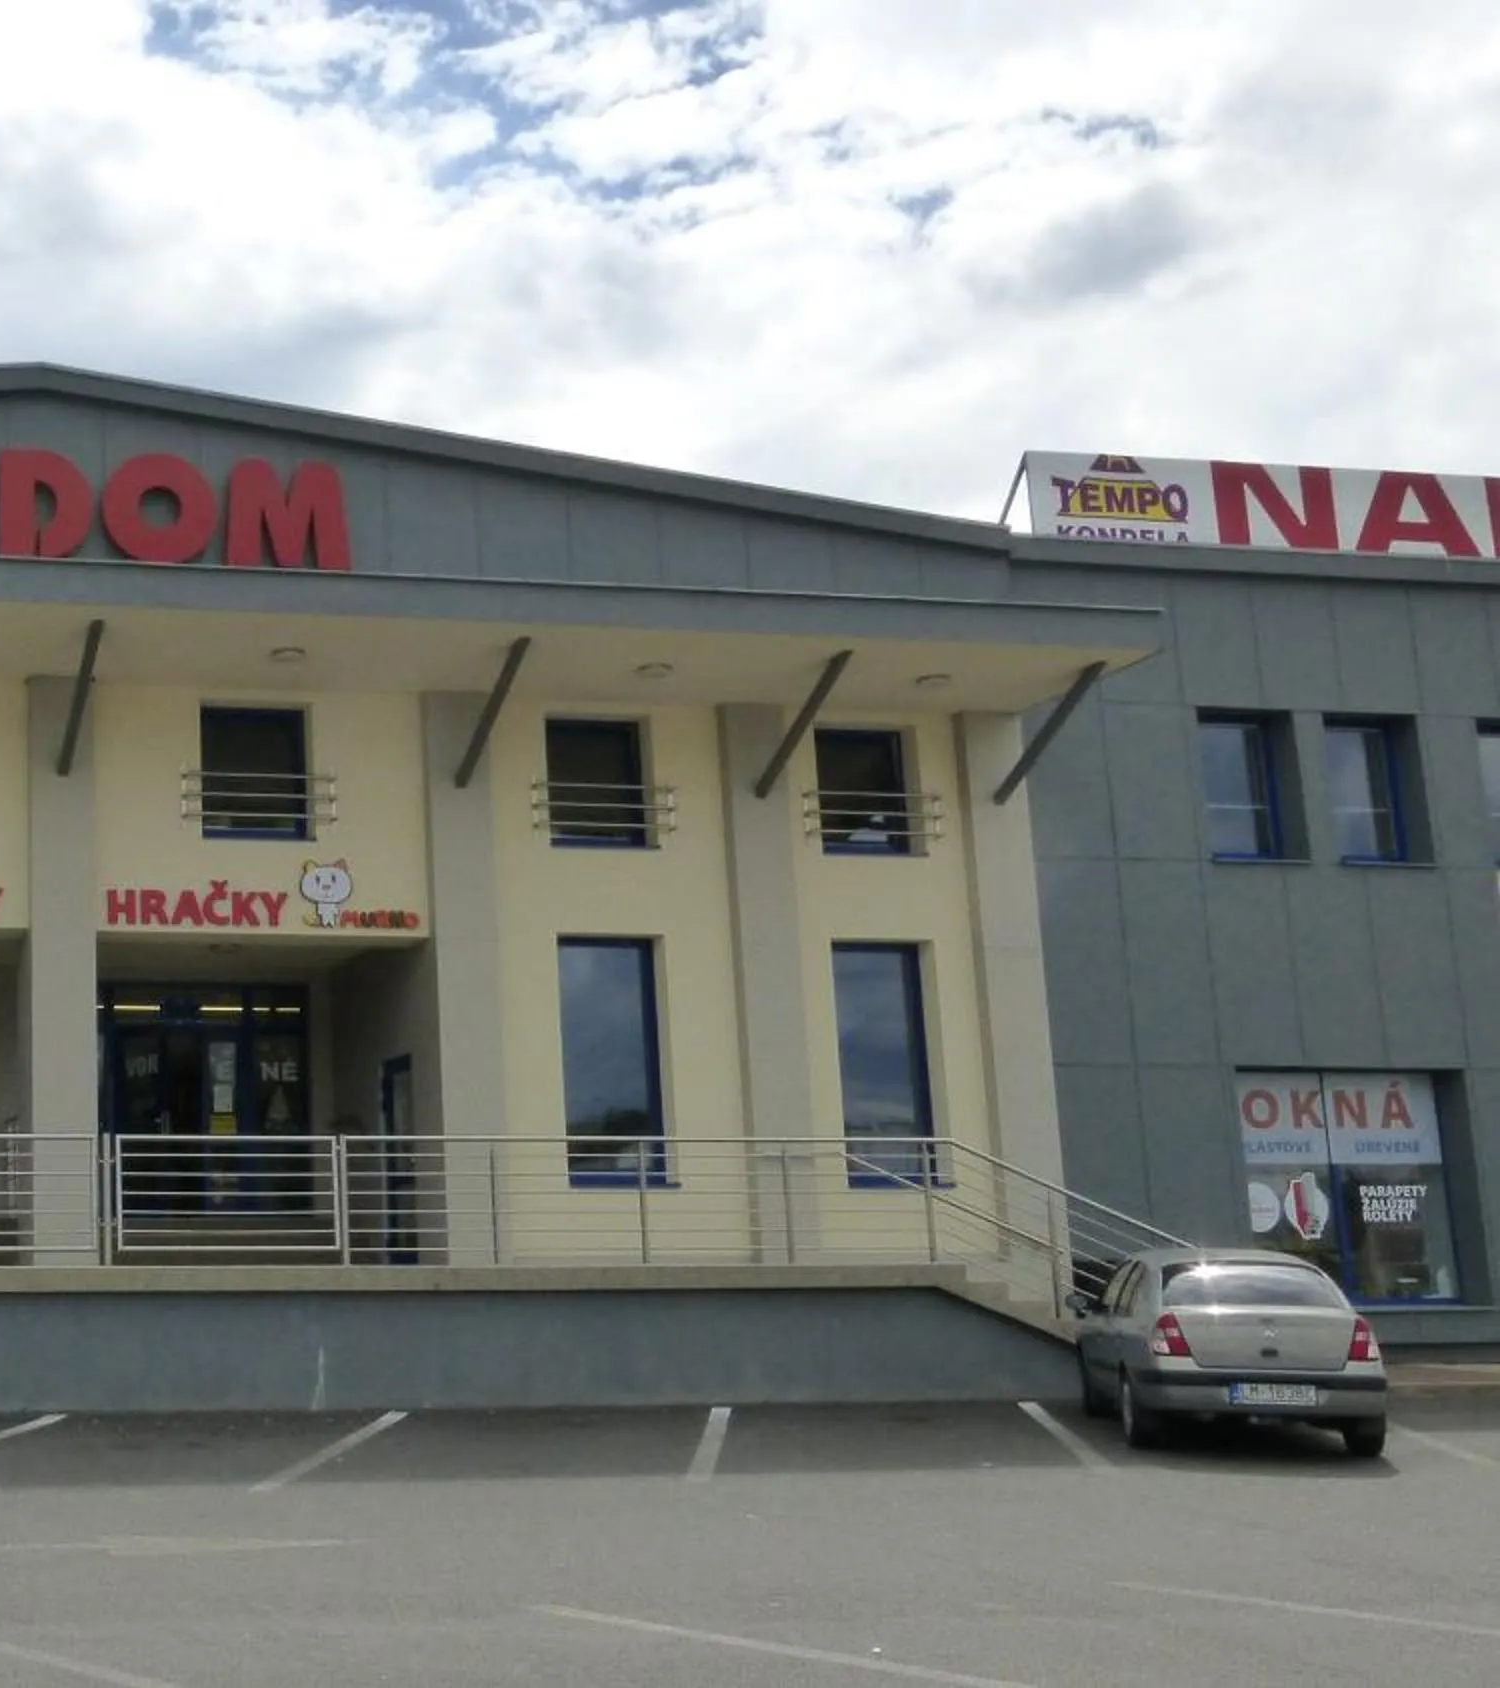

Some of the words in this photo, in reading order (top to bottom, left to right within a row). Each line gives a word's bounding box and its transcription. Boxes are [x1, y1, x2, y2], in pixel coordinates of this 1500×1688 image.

[1051, 476, 1189, 521] TEMPO
[1210, 461, 1500, 557] NA
[106, 879, 288, 927] HRAČKY
[1241, 1080, 1416, 1130] OKNÁ
[1359, 1185, 1427, 1199] PARAPETY
